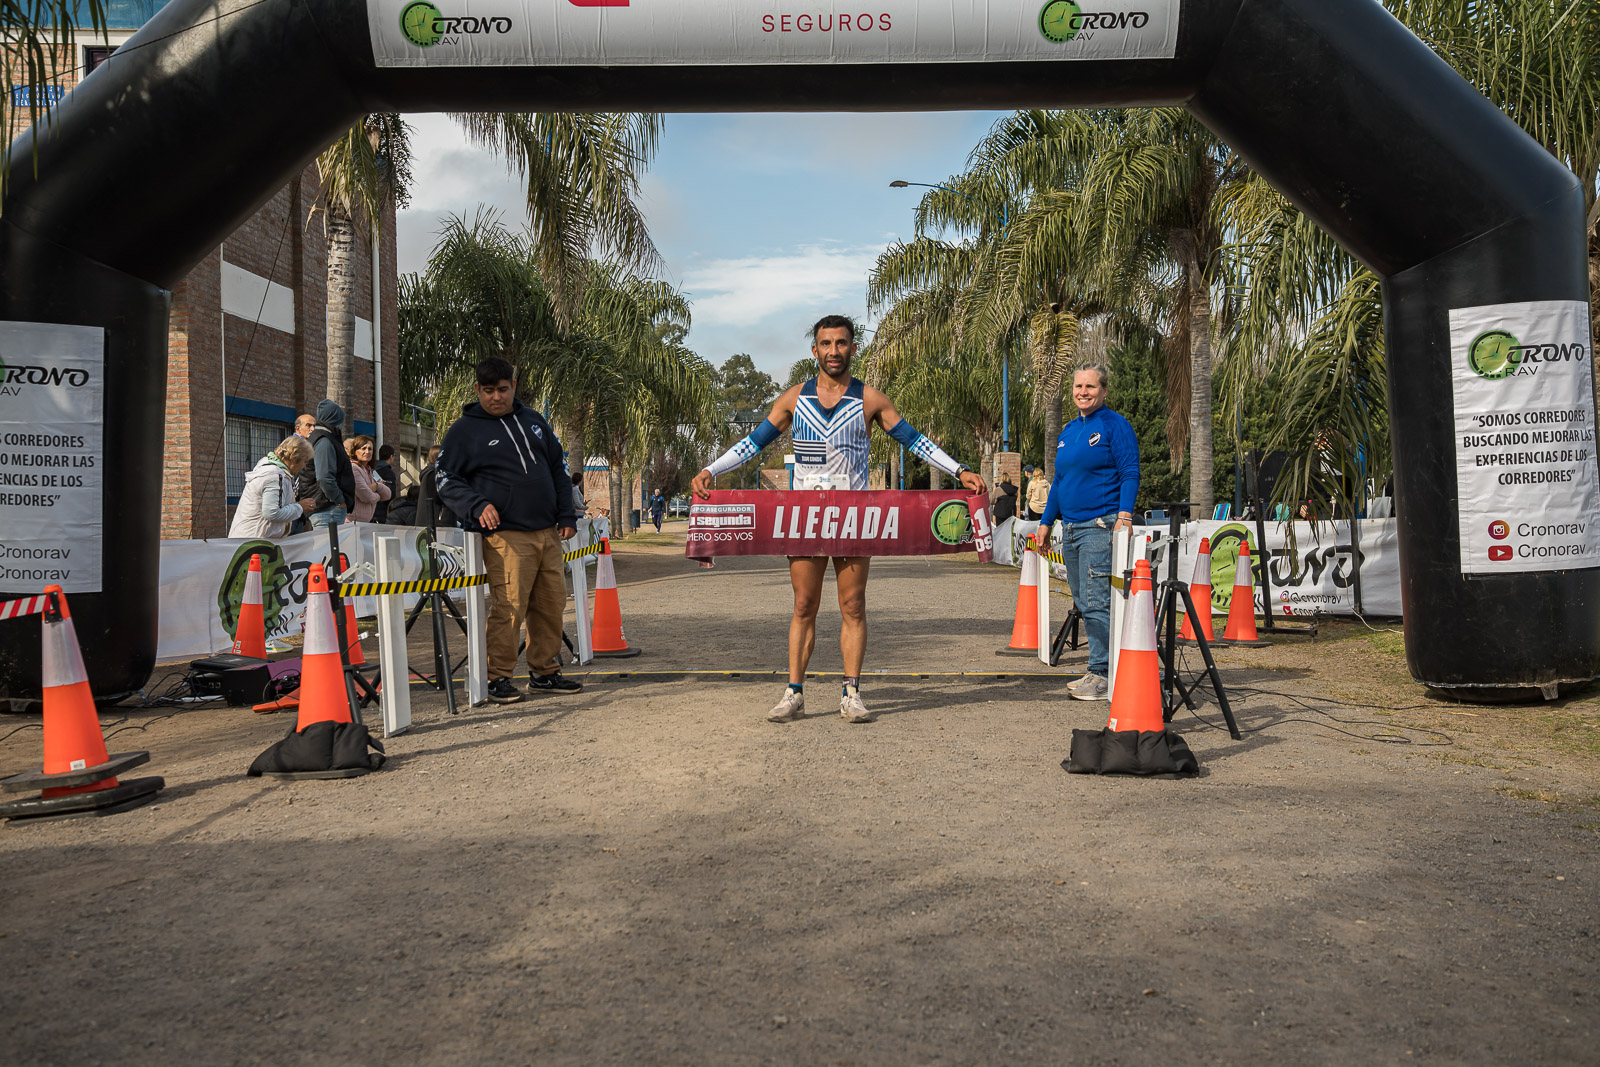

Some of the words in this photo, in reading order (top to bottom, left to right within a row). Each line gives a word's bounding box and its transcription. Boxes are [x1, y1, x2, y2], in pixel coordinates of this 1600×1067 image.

[431, 17, 512, 34] CRONO
[762, 13, 892, 33] SEGUROS
[1069, 12, 1149, 30] CRONO
[431, 37, 460, 46] RAV
[1066, 32, 1095, 41] RAV
[1506, 343, 1584, 364] CRONO
[1505, 366, 1539, 377] RAV
[0, 386, 21, 396] AV
[1523, 410, 1586, 424] CORREDORES
[4, 433, 84, 448] CORREDORES
[1463, 432, 1529, 448] BUSCANDO
[1532, 429, 1580, 444] MEJORAR
[1580, 429, 1593, 442] LAS
[11, 453, 69, 468] MEJORAR
[72, 455, 95, 468] LAS
[1475, 450, 1558, 467] EXPERIENCIAS
[1560, 449, 1573, 463] DE
[1575, 449, 1588, 461] LOS
[0, 473, 38, 487] ENCIAS
[41, 474, 57, 487] DE
[60, 475, 83, 487] LOS
[0, 493, 61, 507] REDORES”
[696, 514, 752, 527] segunda
[772, 506, 900, 540] LLEGADA
[713, 532, 733, 541] SOS
[733, 532, 754, 541] VOS
[1517, 522, 1586, 537] Cronorav
[1518, 544, 1586, 558] Cronorav
